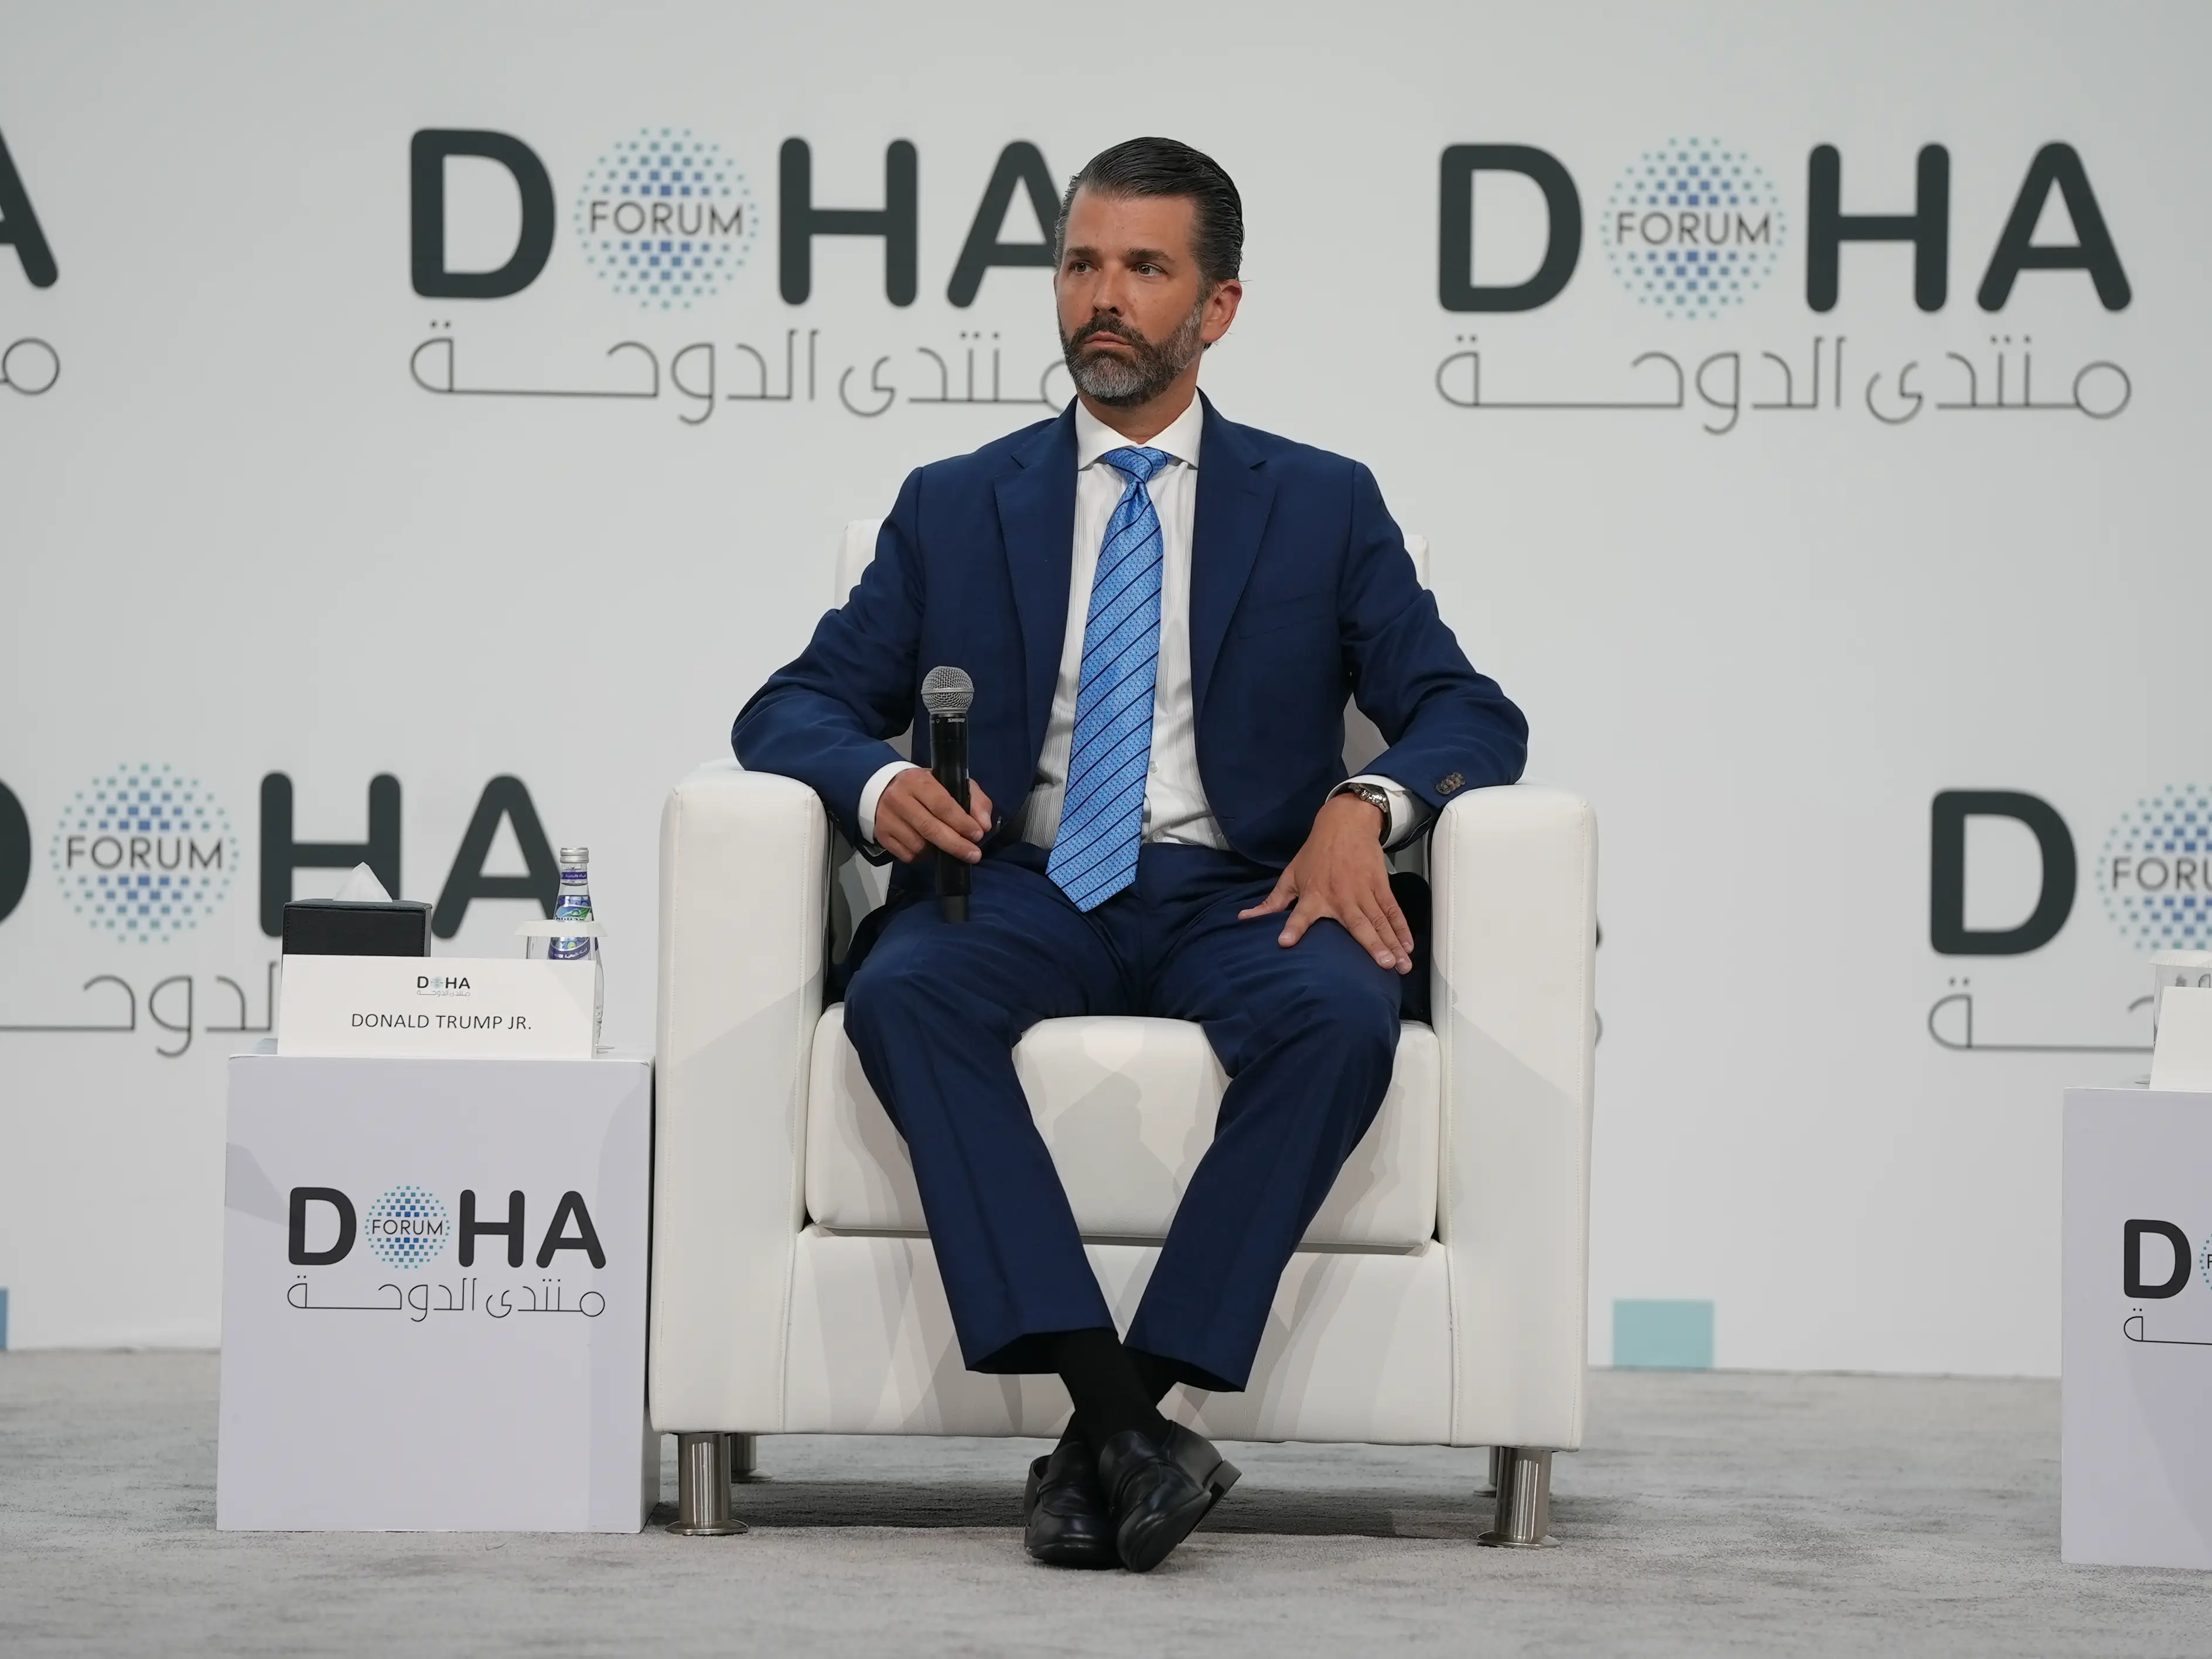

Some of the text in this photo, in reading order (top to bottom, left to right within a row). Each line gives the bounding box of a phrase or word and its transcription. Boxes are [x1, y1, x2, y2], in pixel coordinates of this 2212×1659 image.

[590, 201, 742, 236] FORUM
[1617, 211, 1770, 245] FORUM
[408, 320, 819, 426] الدوحة
[1435, 334, 2132, 435] منتدى الدوحة
[66, 836, 223, 870] FORUM
[351, 1013, 531, 1030] DONALD TRUMP JR.
[372, 1219, 443, 1235] FORUM
[287, 1275, 606, 1322] منتدى الدوحة
